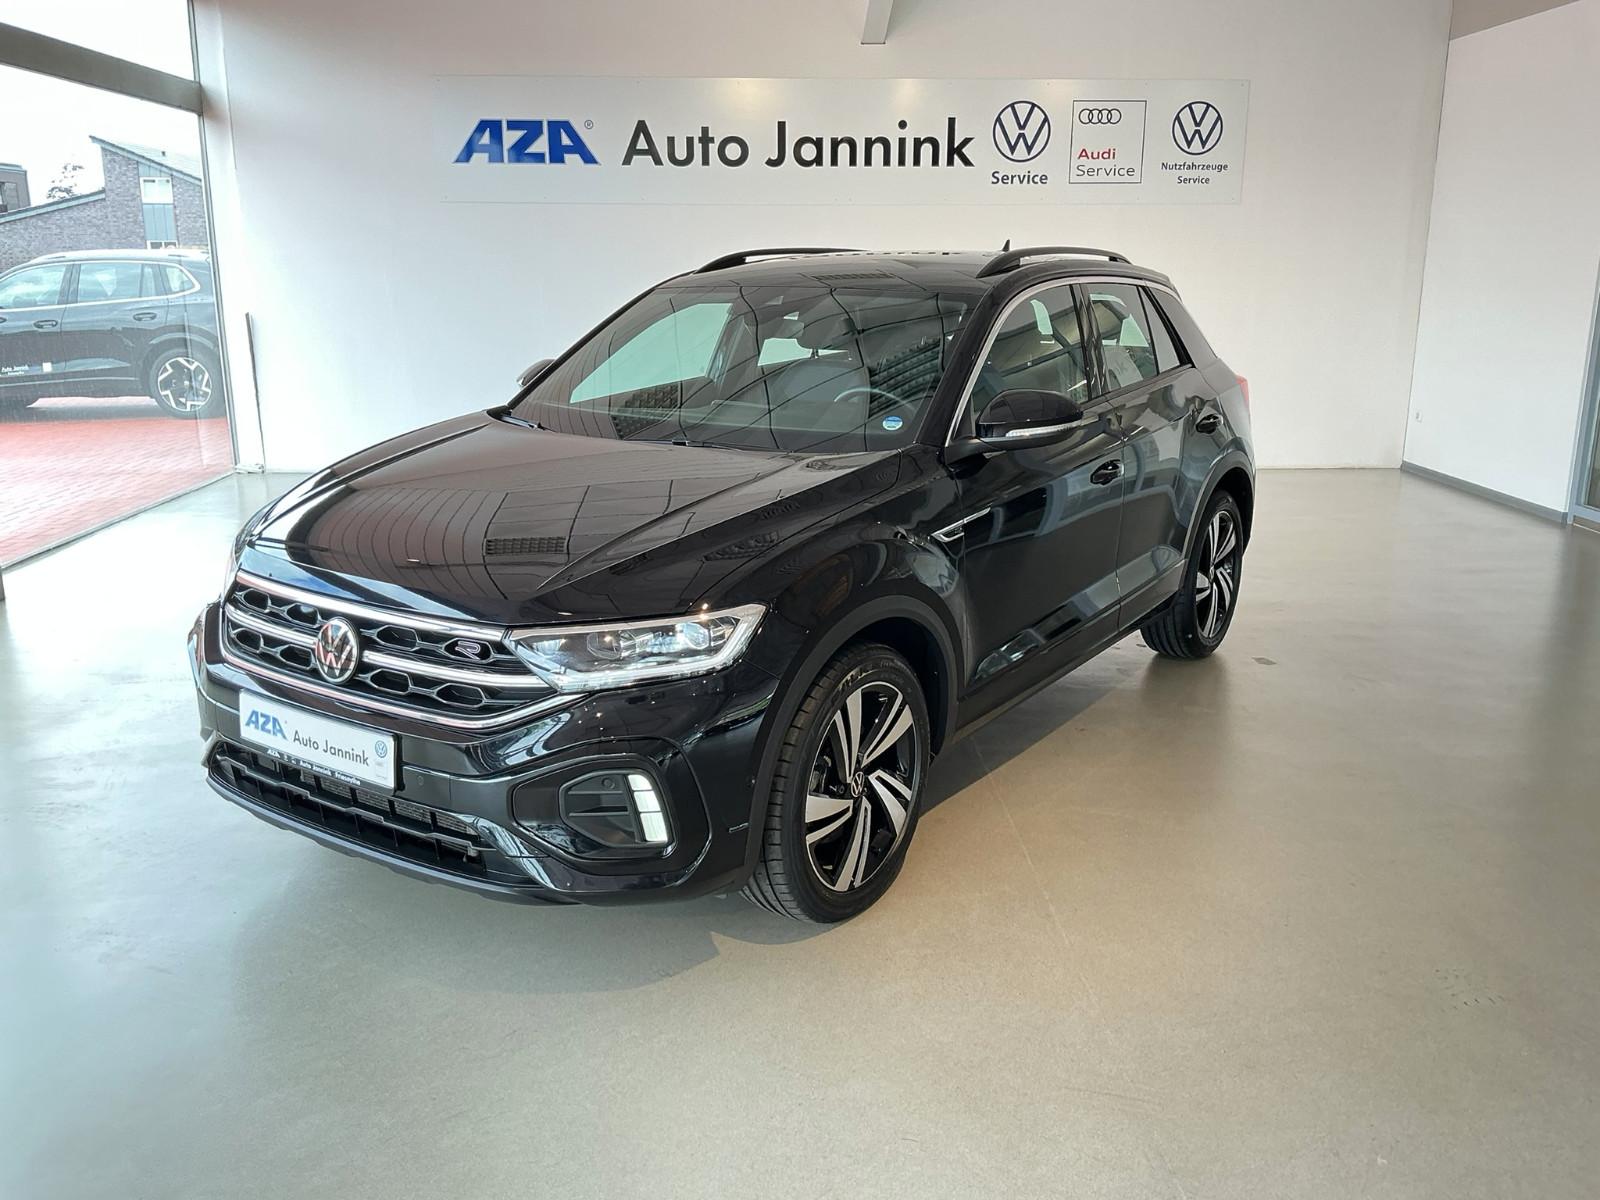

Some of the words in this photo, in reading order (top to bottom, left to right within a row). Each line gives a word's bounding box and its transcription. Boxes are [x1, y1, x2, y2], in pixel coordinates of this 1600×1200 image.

[453, 118, 601, 165] AZA
[621, 119, 750, 168] Auto
[764, 116, 975, 168] Jannink
[1077, 147, 1116, 160] Audi
[1075, 163, 1136, 177] Service
[1160, 161, 1229, 173] Nutzfahrzeuge
[991, 170, 1048, 185] Service
[1176, 175, 1210, 185] Service
[245, 709, 288, 740] AZA
[293, 730, 319, 750] Auto
[323, 739, 369, 766] Jannink
